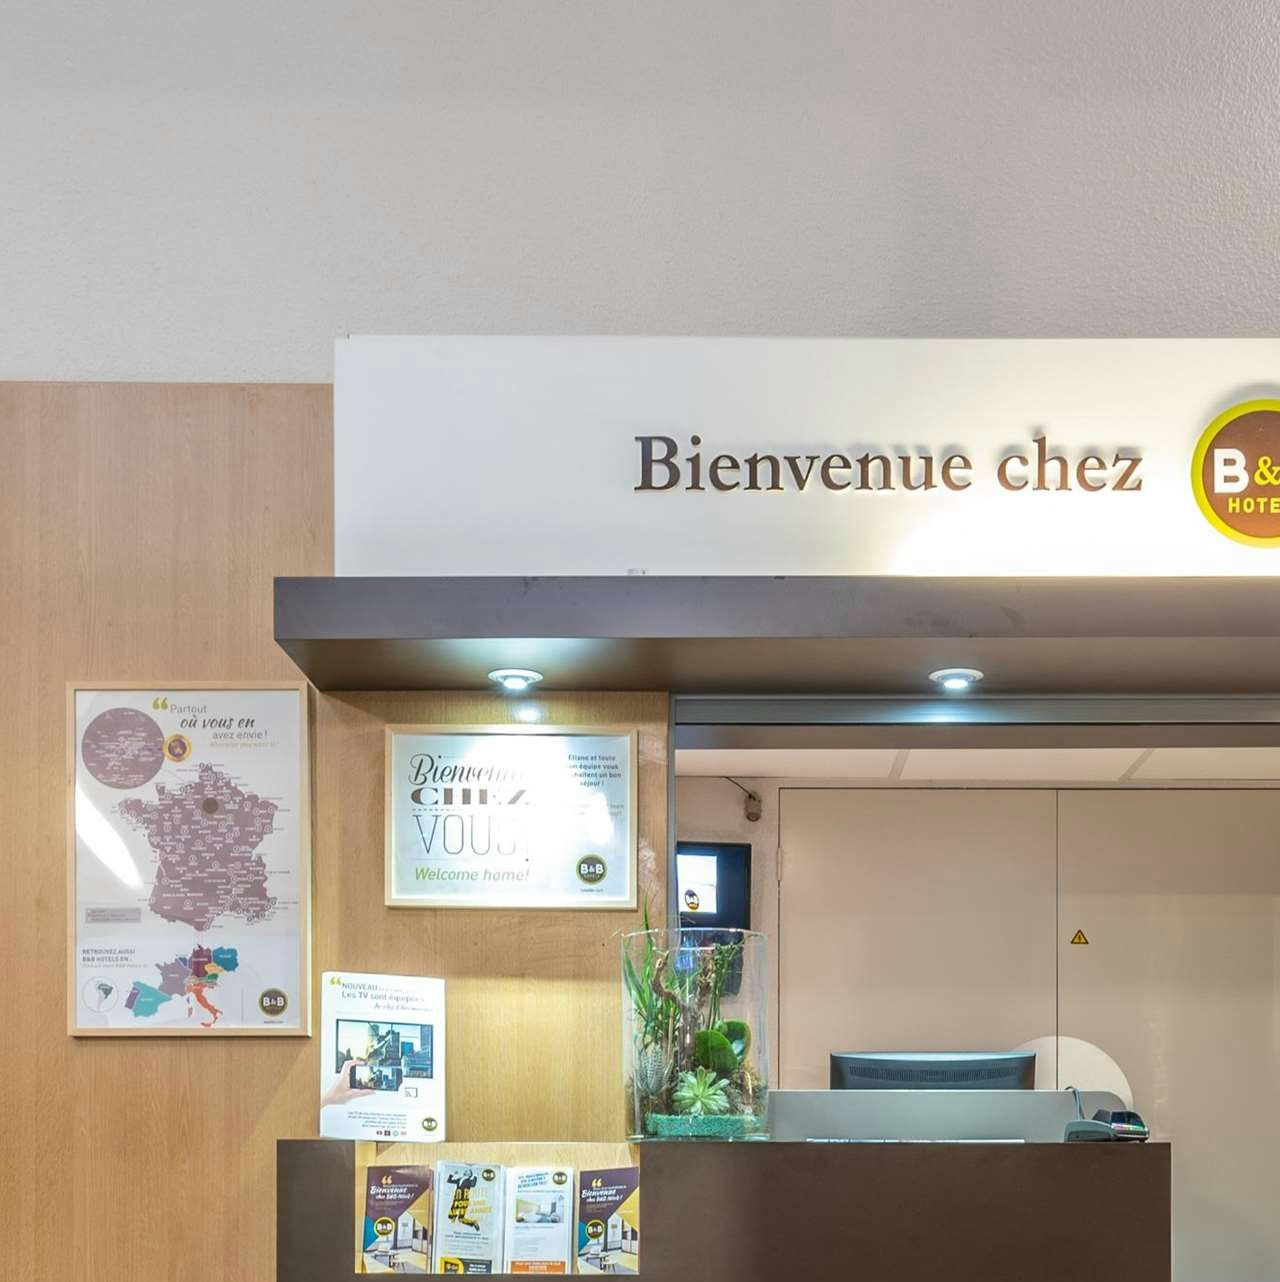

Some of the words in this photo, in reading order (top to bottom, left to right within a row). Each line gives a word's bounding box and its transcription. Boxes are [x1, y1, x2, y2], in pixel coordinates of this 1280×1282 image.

[633, 434, 973, 492] Bienvenue
[996, 435, 1144, 492] chez
[170, 703, 207, 714] Partout
[179, 714, 198, 729] où
[202, 718, 235, 730] vous
[238, 718, 256, 729] en
[212, 731, 234, 740] avez
[414, 867, 479, 881] Welcome
[580, 863, 605, 875] B&B
[342, 982, 378, 991] NOUVEAU
[358, 991, 369, 999] TV
